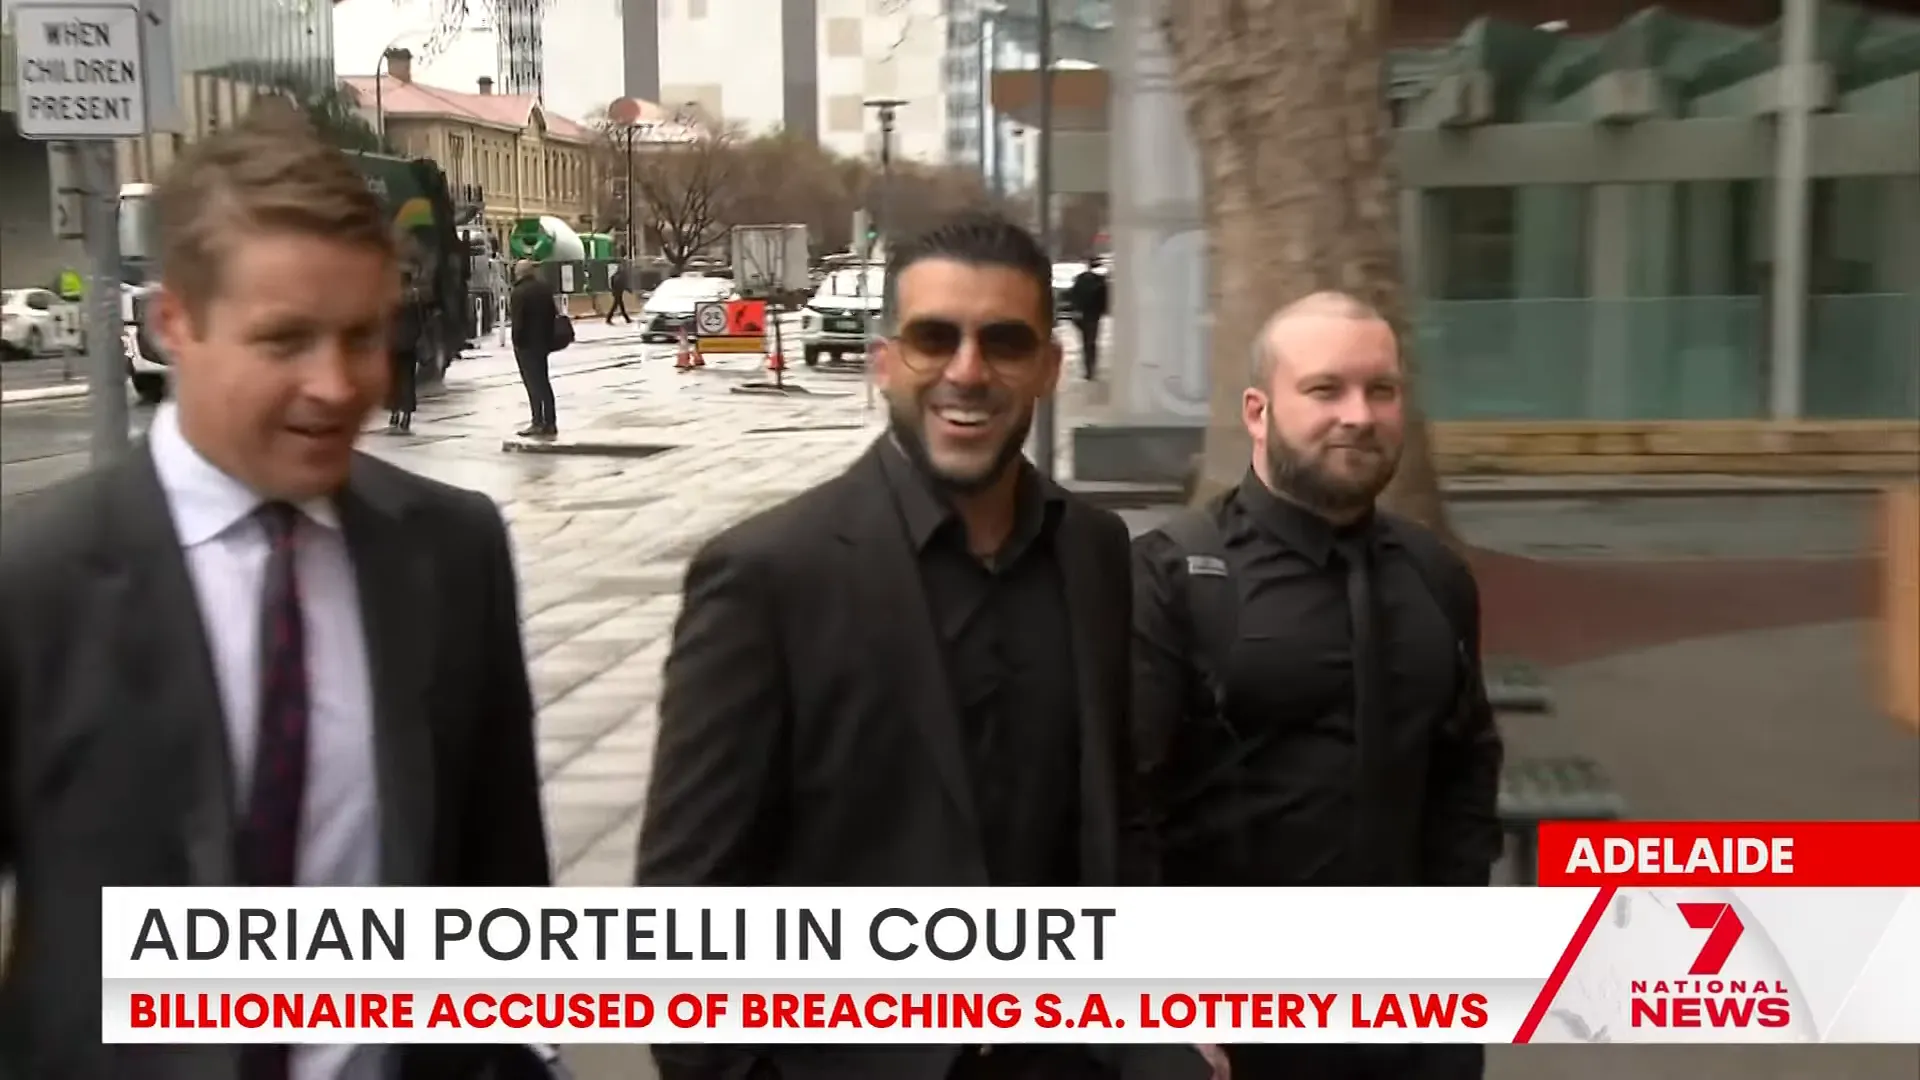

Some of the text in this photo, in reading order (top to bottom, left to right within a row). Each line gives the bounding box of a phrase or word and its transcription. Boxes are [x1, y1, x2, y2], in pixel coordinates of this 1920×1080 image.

[43, 21, 110, 47] WHEN
[22, 58, 135, 84] CHILDREN
[27, 95, 132, 120] PRESENT
[704, 311, 721, 326] 25
